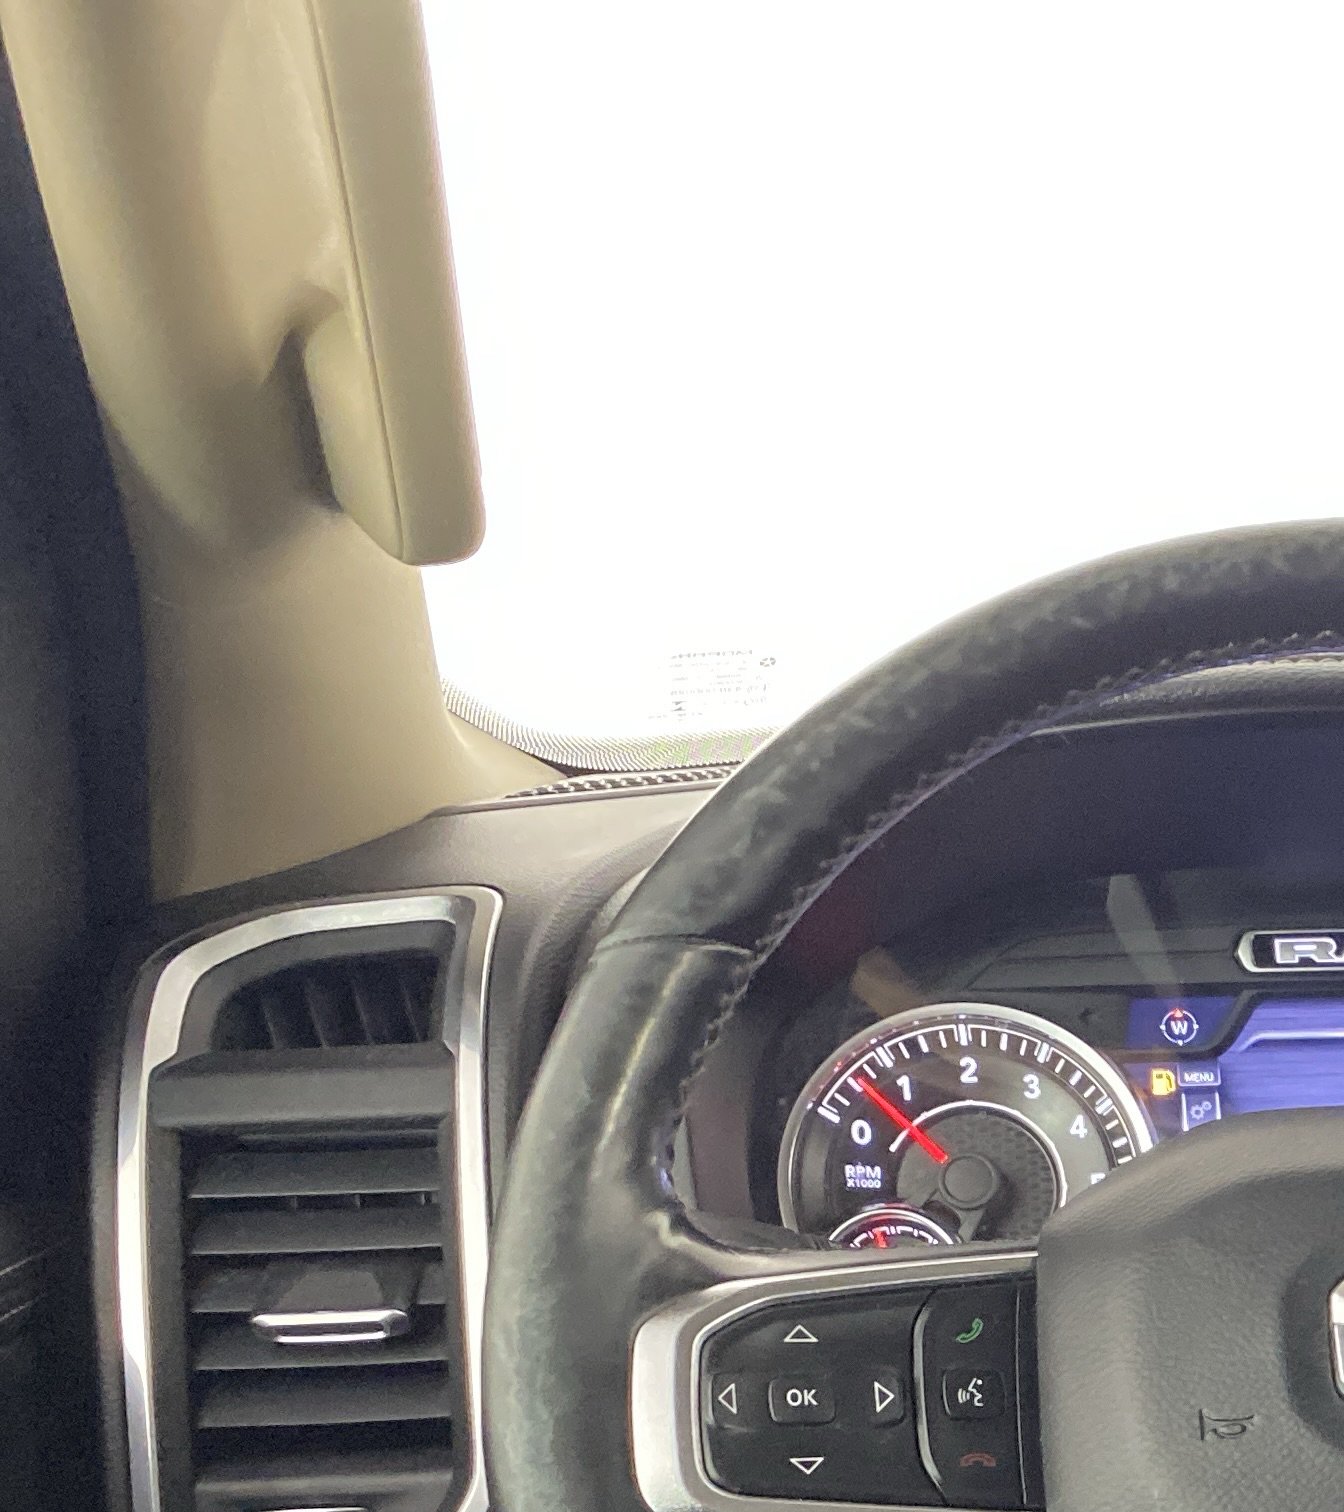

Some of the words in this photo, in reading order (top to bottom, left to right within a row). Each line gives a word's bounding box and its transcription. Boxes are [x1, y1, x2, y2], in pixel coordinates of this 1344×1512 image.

[1170, 1019, 1190, 1036] W
[959, 1056, 979, 1084] 2
[896, 1074, 912, 1101] 1
[1023, 1073, 1041, 1099] 3
[851, 1119, 873, 1146] 0
[1070, 1114, 1088, 1139] 4
[844, 1164, 882, 1179] RPM
[786, 1388, 818, 1407] OK
